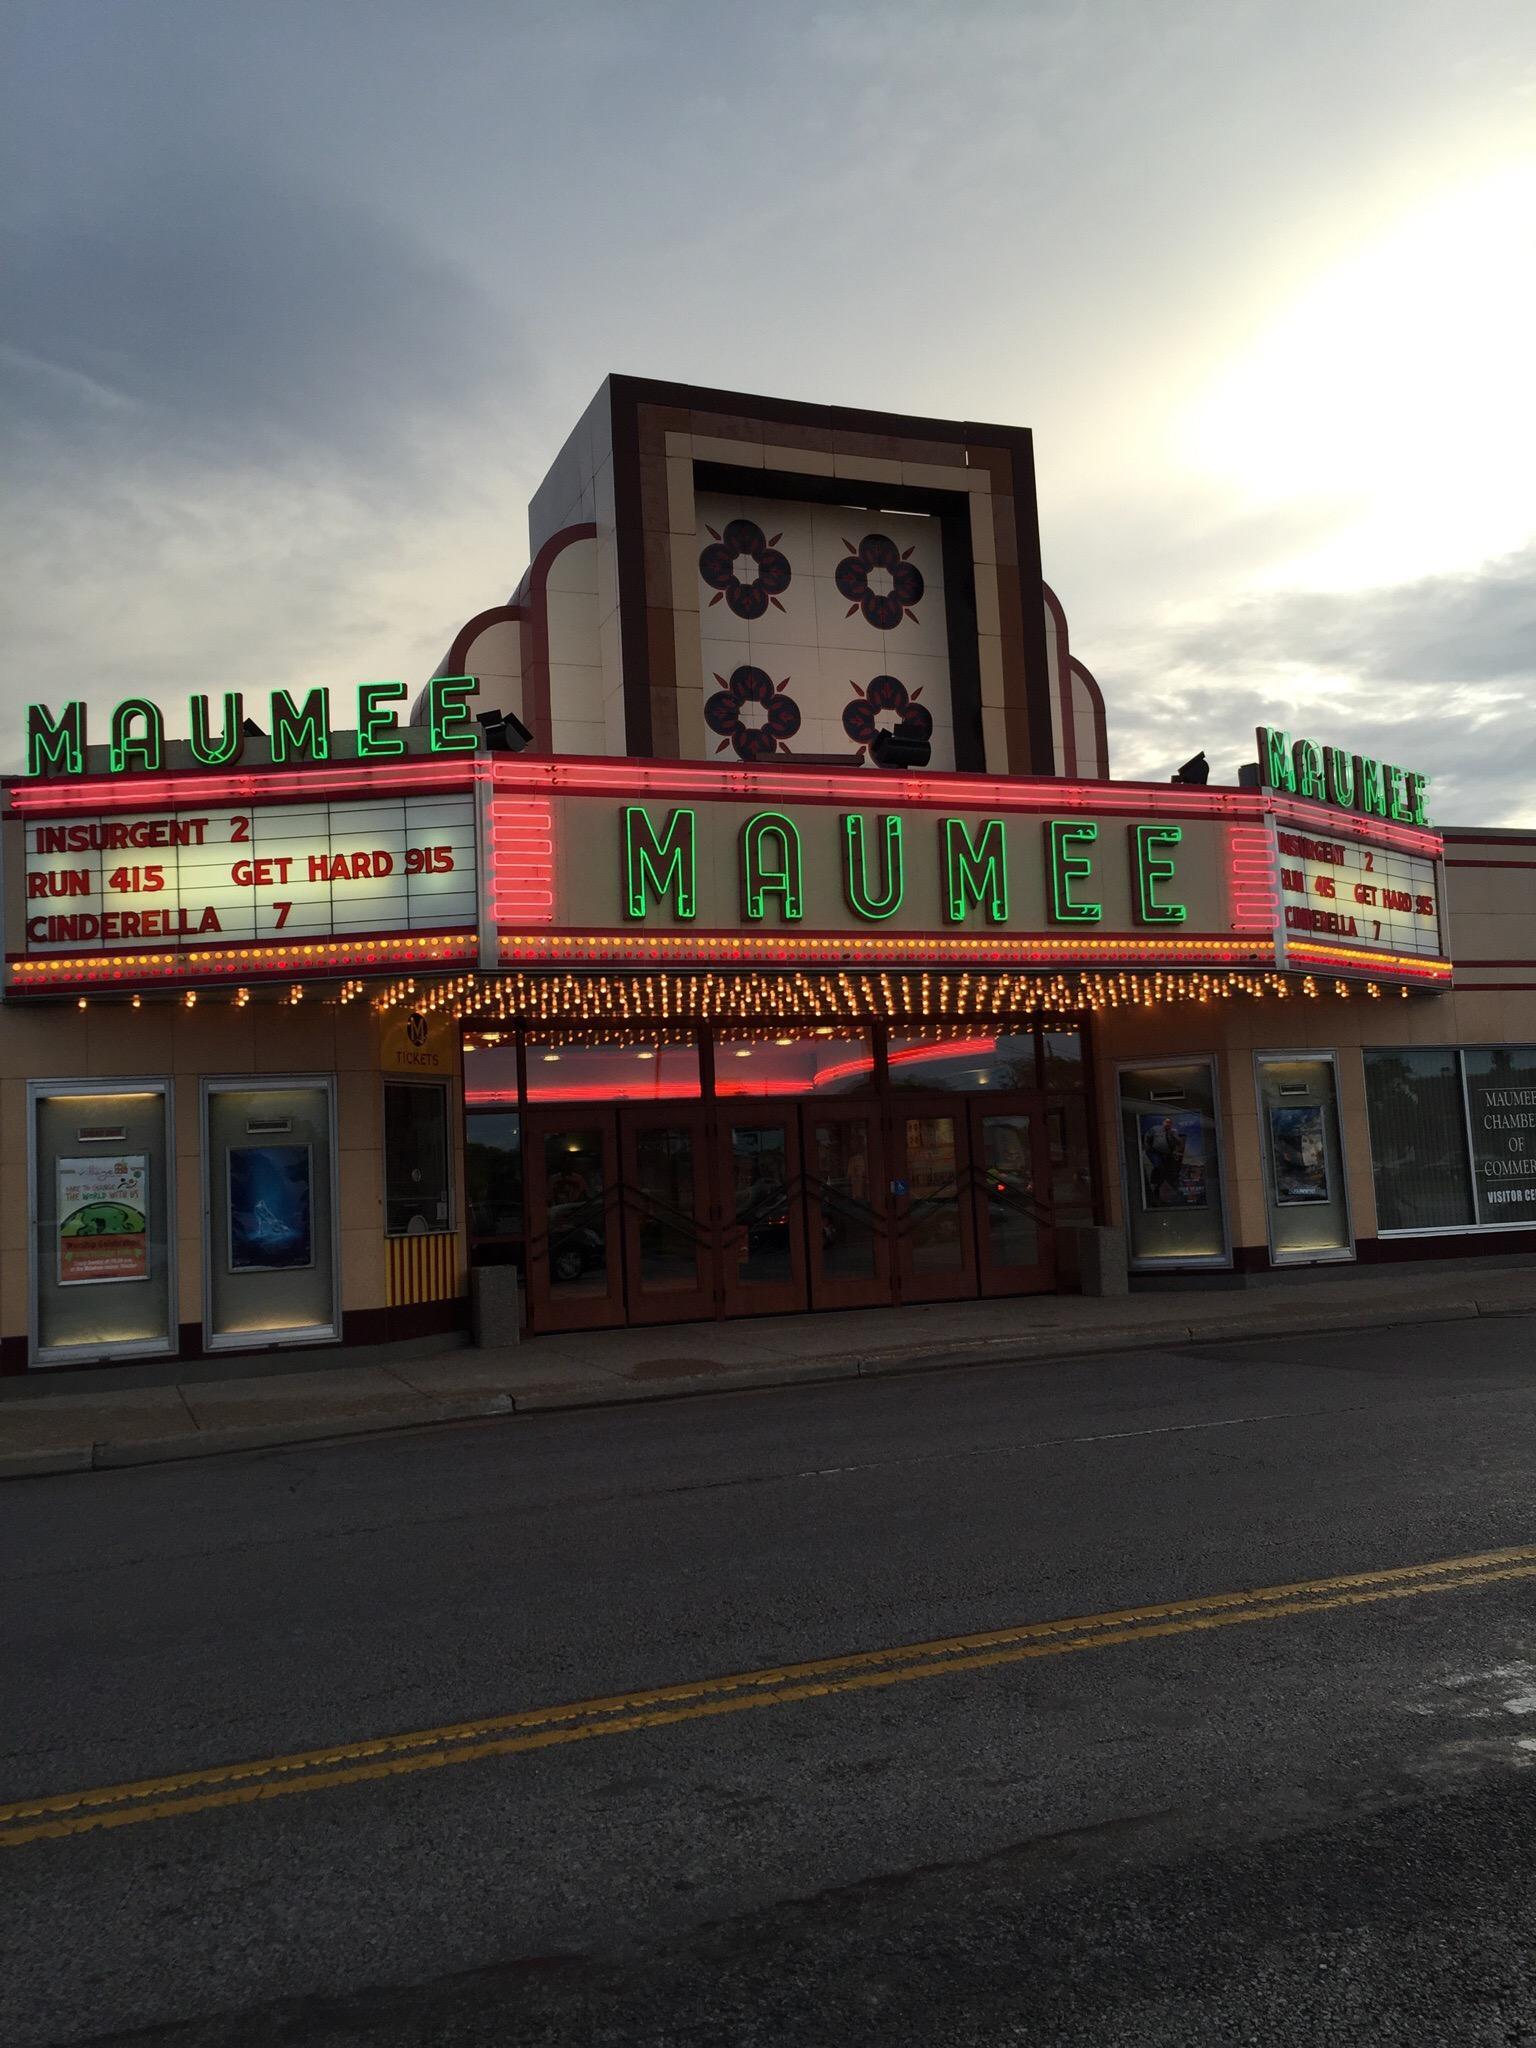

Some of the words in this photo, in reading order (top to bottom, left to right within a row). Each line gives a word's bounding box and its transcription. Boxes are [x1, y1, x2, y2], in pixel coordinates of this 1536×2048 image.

[26, 676, 480, 776] MAUMEE
[1256, 727, 1434, 827] MAUMEE
[36, 818, 209, 854] INSURGENT
[230, 815, 250, 843] 2
[1277, 831, 1346, 866] INSURGENT
[1364, 851, 1374, 872] 2
[28, 869, 90, 898] RUN
[109, 865, 164, 893] 415
[231, 857, 293, 887] GET
[308, 850, 394, 883] HARD
[405, 846, 454, 875] 915
[622, 806, 1188, 925] MAUMEE
[1281, 868, 1304, 893] RUN
[1354, 883, 1377, 906] GET
[1383, 888, 1412, 912] HARD
[27, 906, 222, 943] CINDERELLA
[273, 902, 292, 929] 7
[1285, 905, 1358, 937] CINDERELLA
[1373, 920, 1381, 940] 7
[396, 1050, 439, 1066] TICKETS
[1485, 1091, 1536, 1106] MAUMEE
[1508, 1137, 1525, 1152] OF
[82, 1192, 107, 1200] WORLD
[1487, 1190, 1523, 1203] VISITOR
[1524, 1189, 1536, 1201] CE
